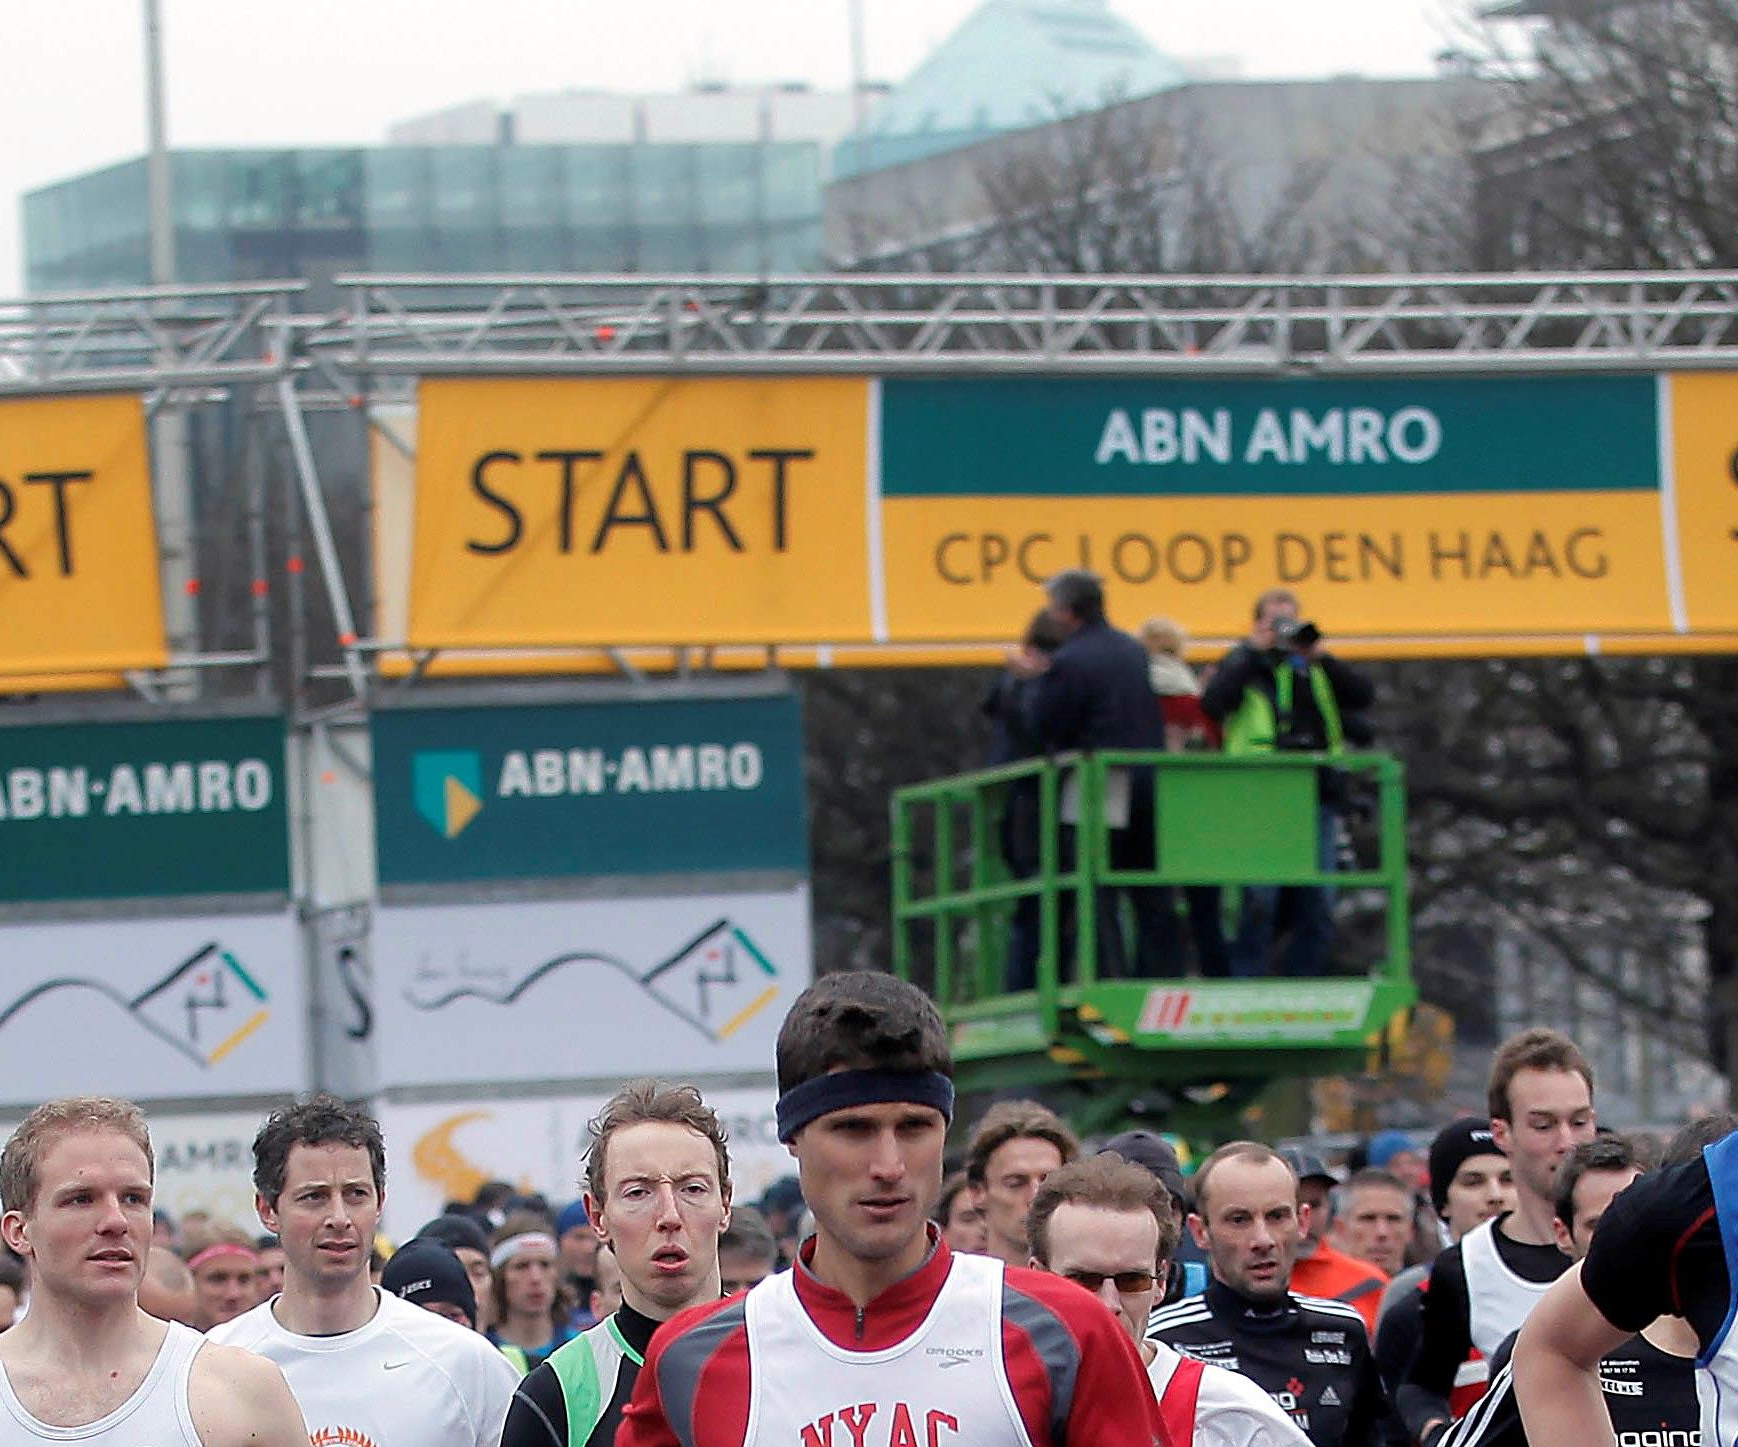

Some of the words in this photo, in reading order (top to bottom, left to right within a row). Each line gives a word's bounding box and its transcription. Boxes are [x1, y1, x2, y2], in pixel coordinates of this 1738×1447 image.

[1094, 407, 1231, 465] ABN
[1244, 404, 1442, 465] AMRO
[466, 446, 817, 557] START
[934, 531, 1055, 586] CPC
[1276, 531, 1406, 584] DEN
[1427, 526, 1611, 582] HAAG
[161, 1138, 244, 1171] AMR
[925, 1346, 984, 1358] BROOKS
